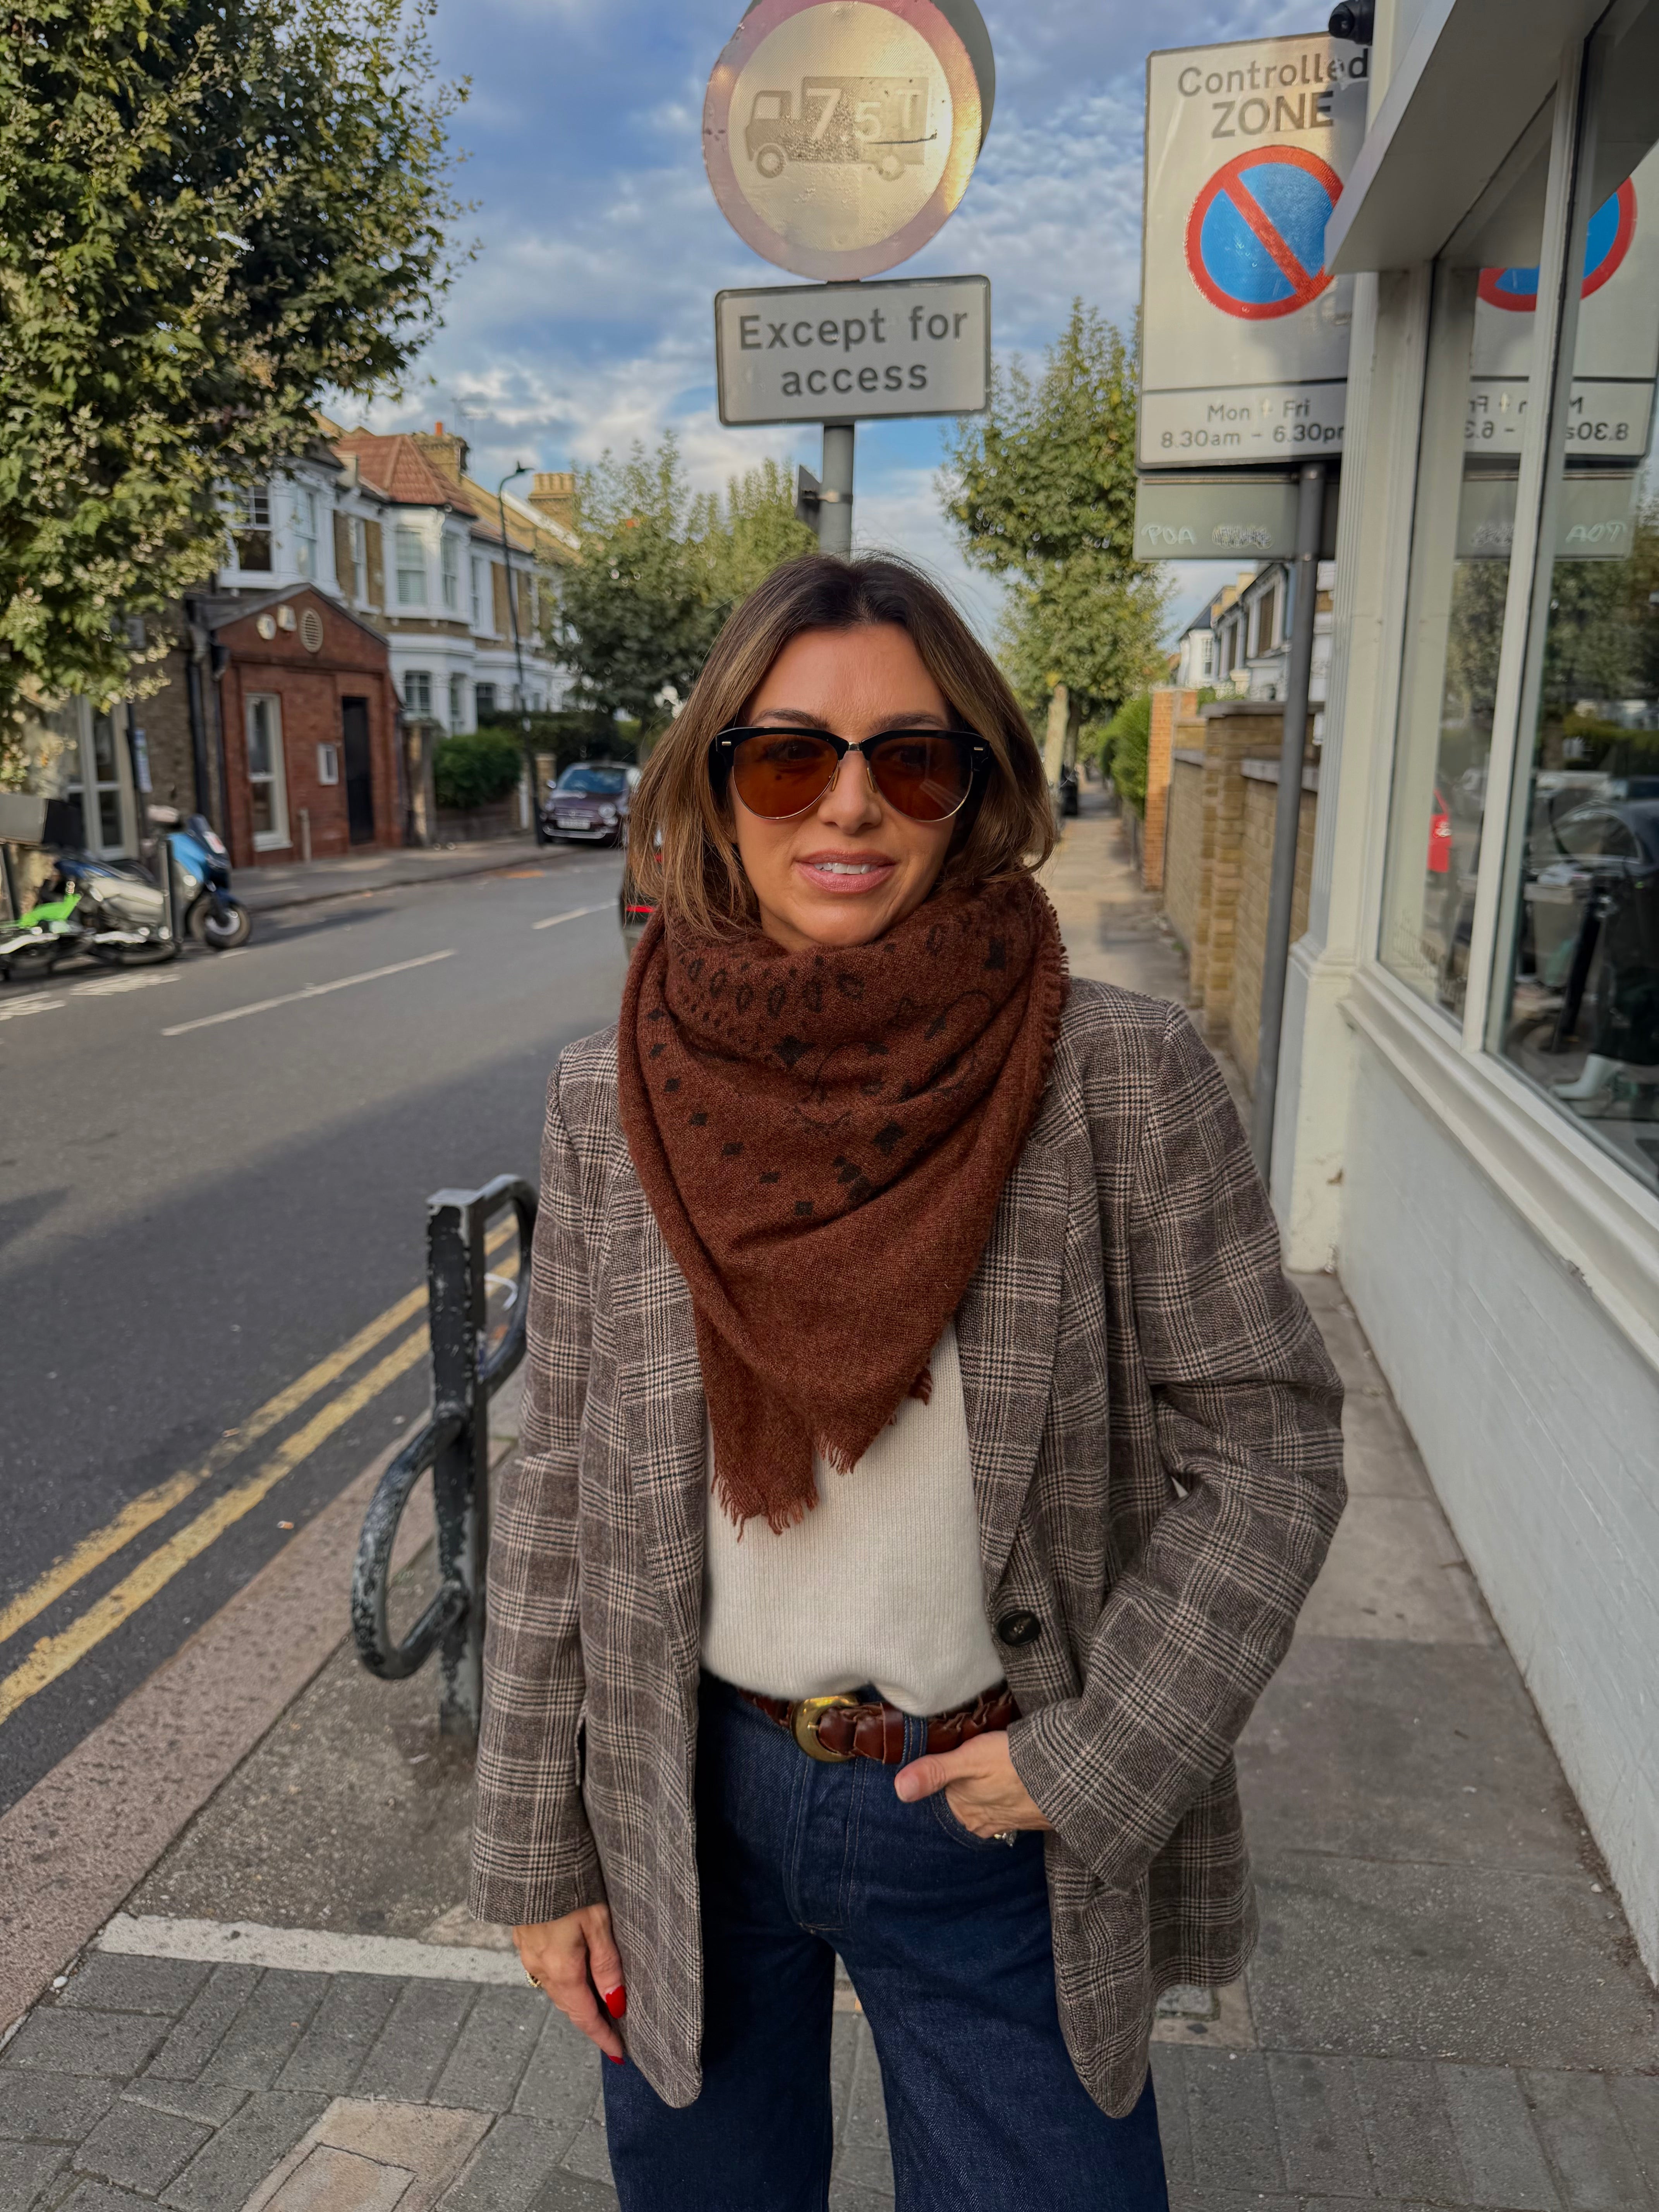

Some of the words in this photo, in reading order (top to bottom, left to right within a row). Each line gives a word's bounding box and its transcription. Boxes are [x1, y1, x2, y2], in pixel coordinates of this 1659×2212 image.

[1178, 48, 1368, 97] Controlled
[1212, 91, 1334, 139] ZONE
[739, 308, 886, 352] Except
[909, 306, 967, 341] for
[781, 364, 927, 397] access
[1207, 404, 1250, 422] Mon
[1283, 399, 1310, 417] Fri
[1161, 429, 1241, 449] 8.30am
